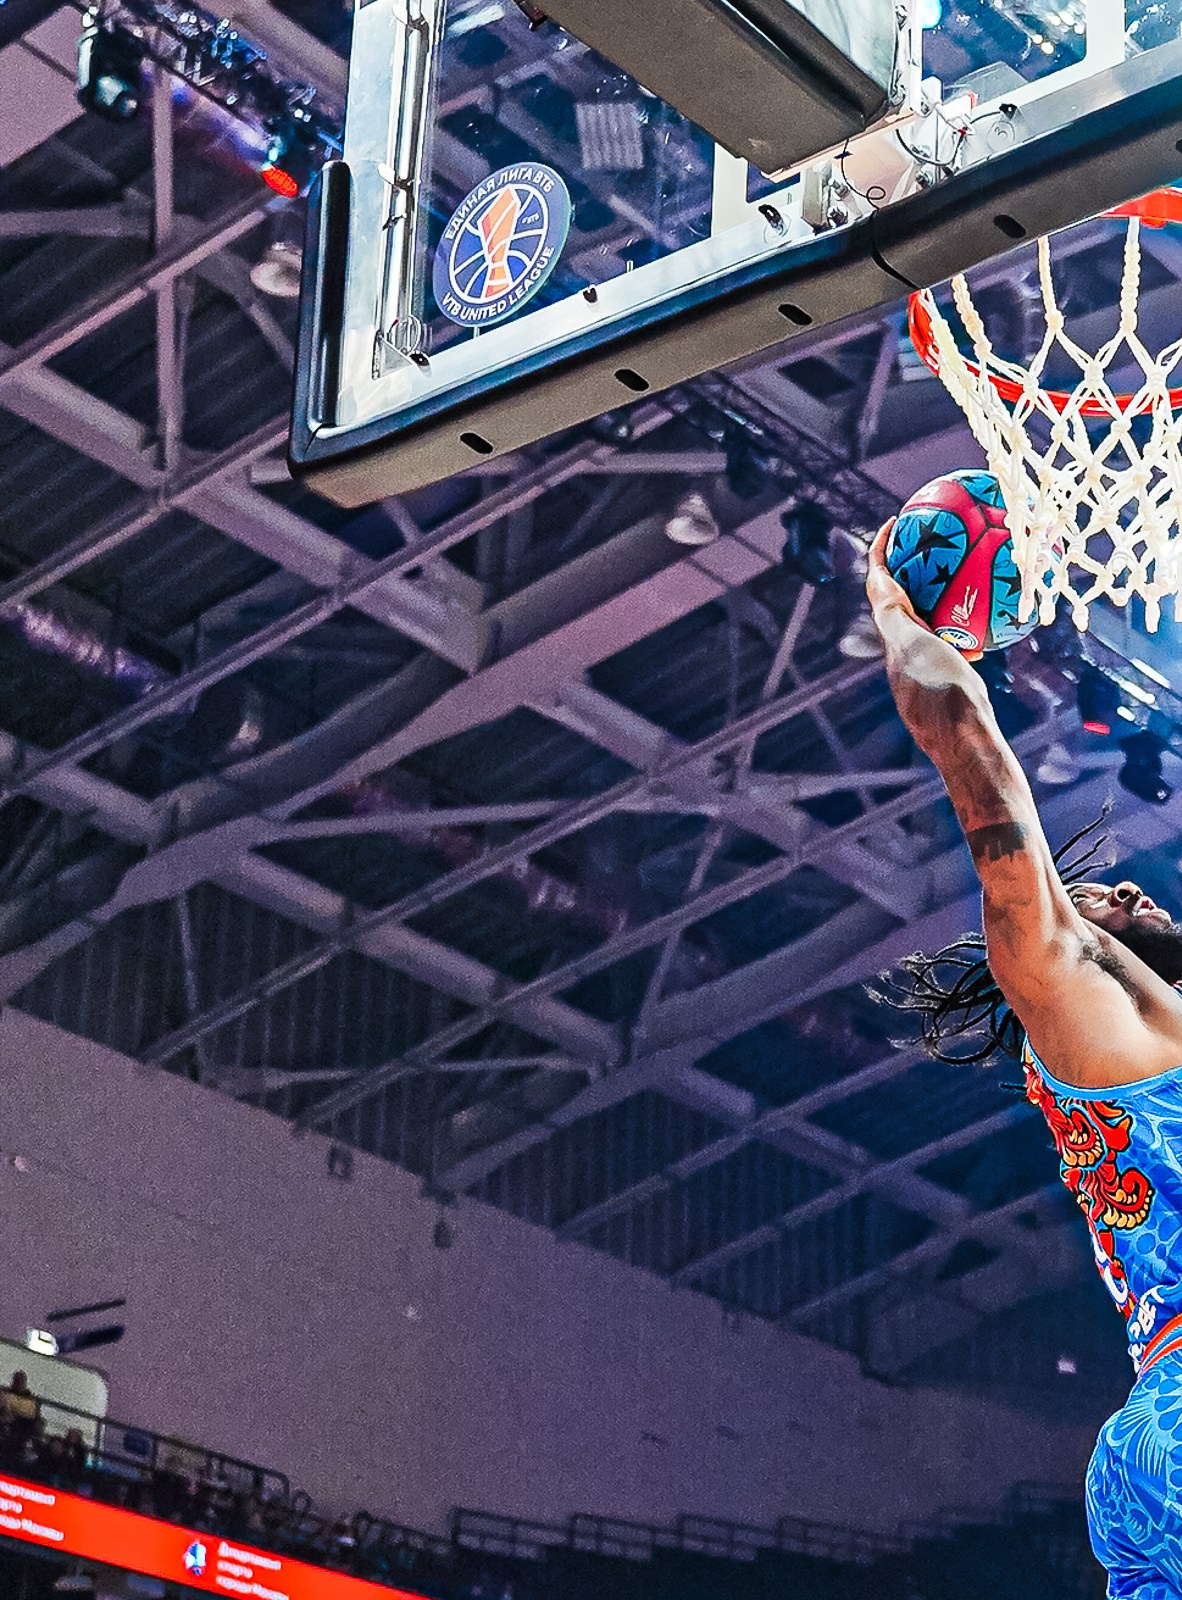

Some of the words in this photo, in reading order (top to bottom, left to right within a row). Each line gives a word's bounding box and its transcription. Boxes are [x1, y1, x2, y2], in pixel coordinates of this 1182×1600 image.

[444, 179, 496, 240] ЕДИНАЯ
[498, 167, 535, 186] ЛИГА
[533, 171, 555, 193] ВТБ
[442, 291, 462, 316] VTB
[460, 302, 507, 321] UNITED
[509, 246, 554, 304] LEAGUE
